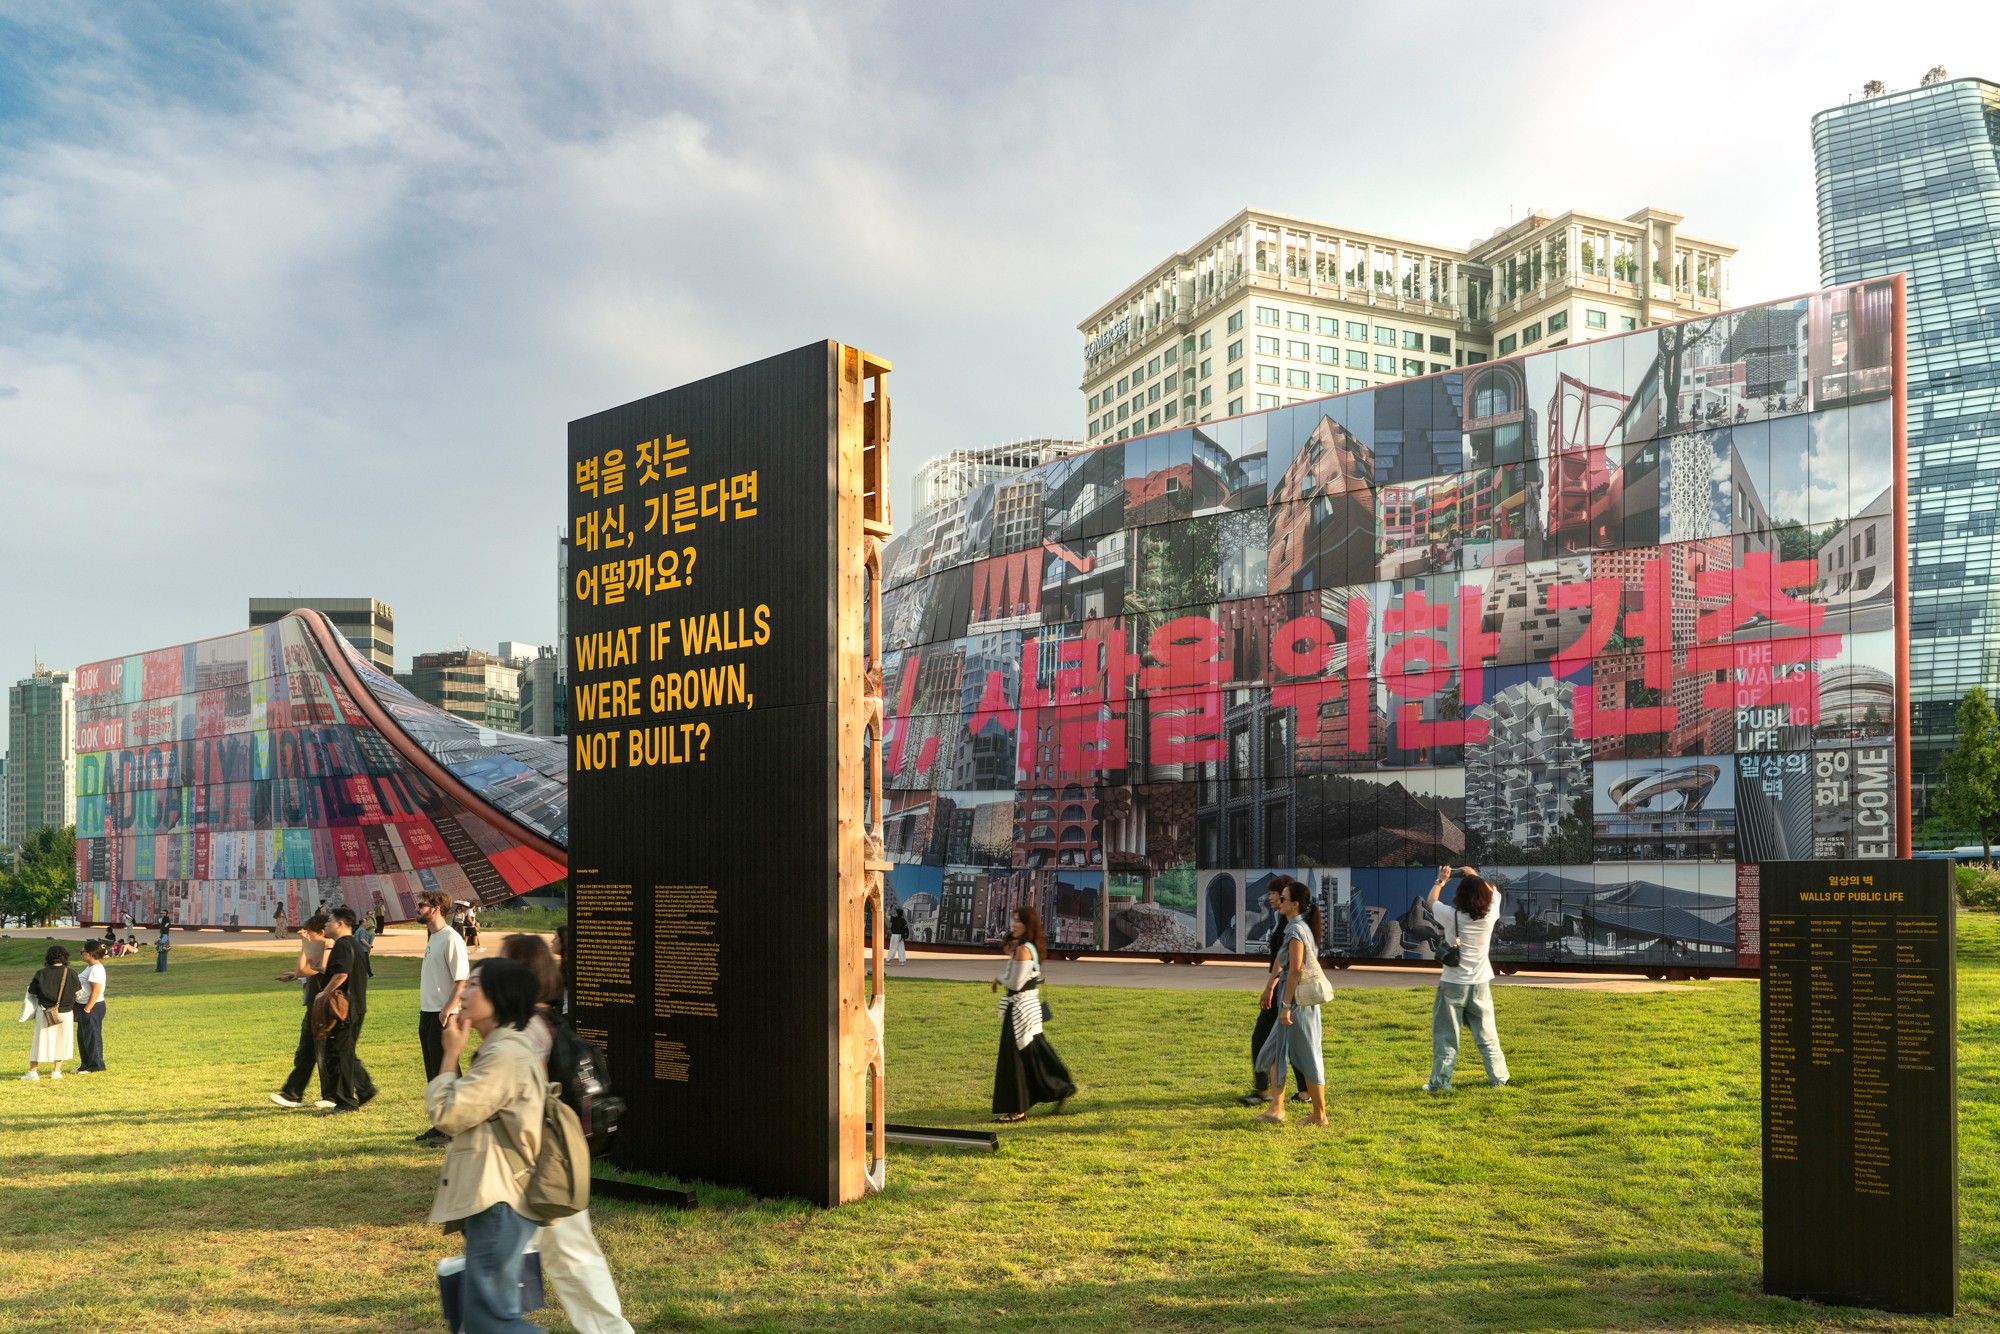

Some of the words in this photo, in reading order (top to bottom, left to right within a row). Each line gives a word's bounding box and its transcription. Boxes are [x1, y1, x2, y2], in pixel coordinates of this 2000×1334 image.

[1084, 315, 1132, 361] SOMERSET
[576, 448, 626, 499] 벽을
[636, 434, 689, 485] 짓는
[575, 504, 634, 552] 대신,
[645, 470, 758, 535] 기른다면
[575, 546, 697, 605] 어떨까요?
[576, 626, 641, 671] WHAT
[651, 621, 671, 661] IF
[680, 604, 771, 656] WALLS
[968, 616, 1233, 772] 사람을
[1271, 584, 1499, 754] 위한
[1547, 551, 1843, 739] 건축
[1737, 645, 1772, 666] THE
[76, 669, 99, 691] LOOK
[111, 664, 123, 685] UP
[204, 672, 219, 687] THIS
[231, 667, 245, 683] NOT
[1737, 663, 1806, 687] WALLS
[202, 689, 225, 706] ABOUT
[576, 678, 641, 721] WERE
[651, 663, 753, 713] GROWN,
[1737, 688, 1761, 709] OF
[1737, 707, 1809, 730] PUBLIC
[76, 727, 99, 749] LOOK
[104, 723, 123, 746] OUT
[576, 731, 620, 771] NOT
[629, 723, 711, 767] BUILT?
[1737, 731, 1778, 751] LIFE
[1739, 753, 1807, 778] 일상의
[1762, 778, 1783, 801] 벽
[1815, 751, 1850, 807] 환영
[1829, 875, 1860, 886] 일상의
[1862, 875, 1873, 886] 벽
[1800, 892, 1831, 901] WALLS
[1834, 892, 1845, 901] OF
[1849, 892, 1881, 901] PUBLIC
[1884, 892, 1904, 901] LIFE
